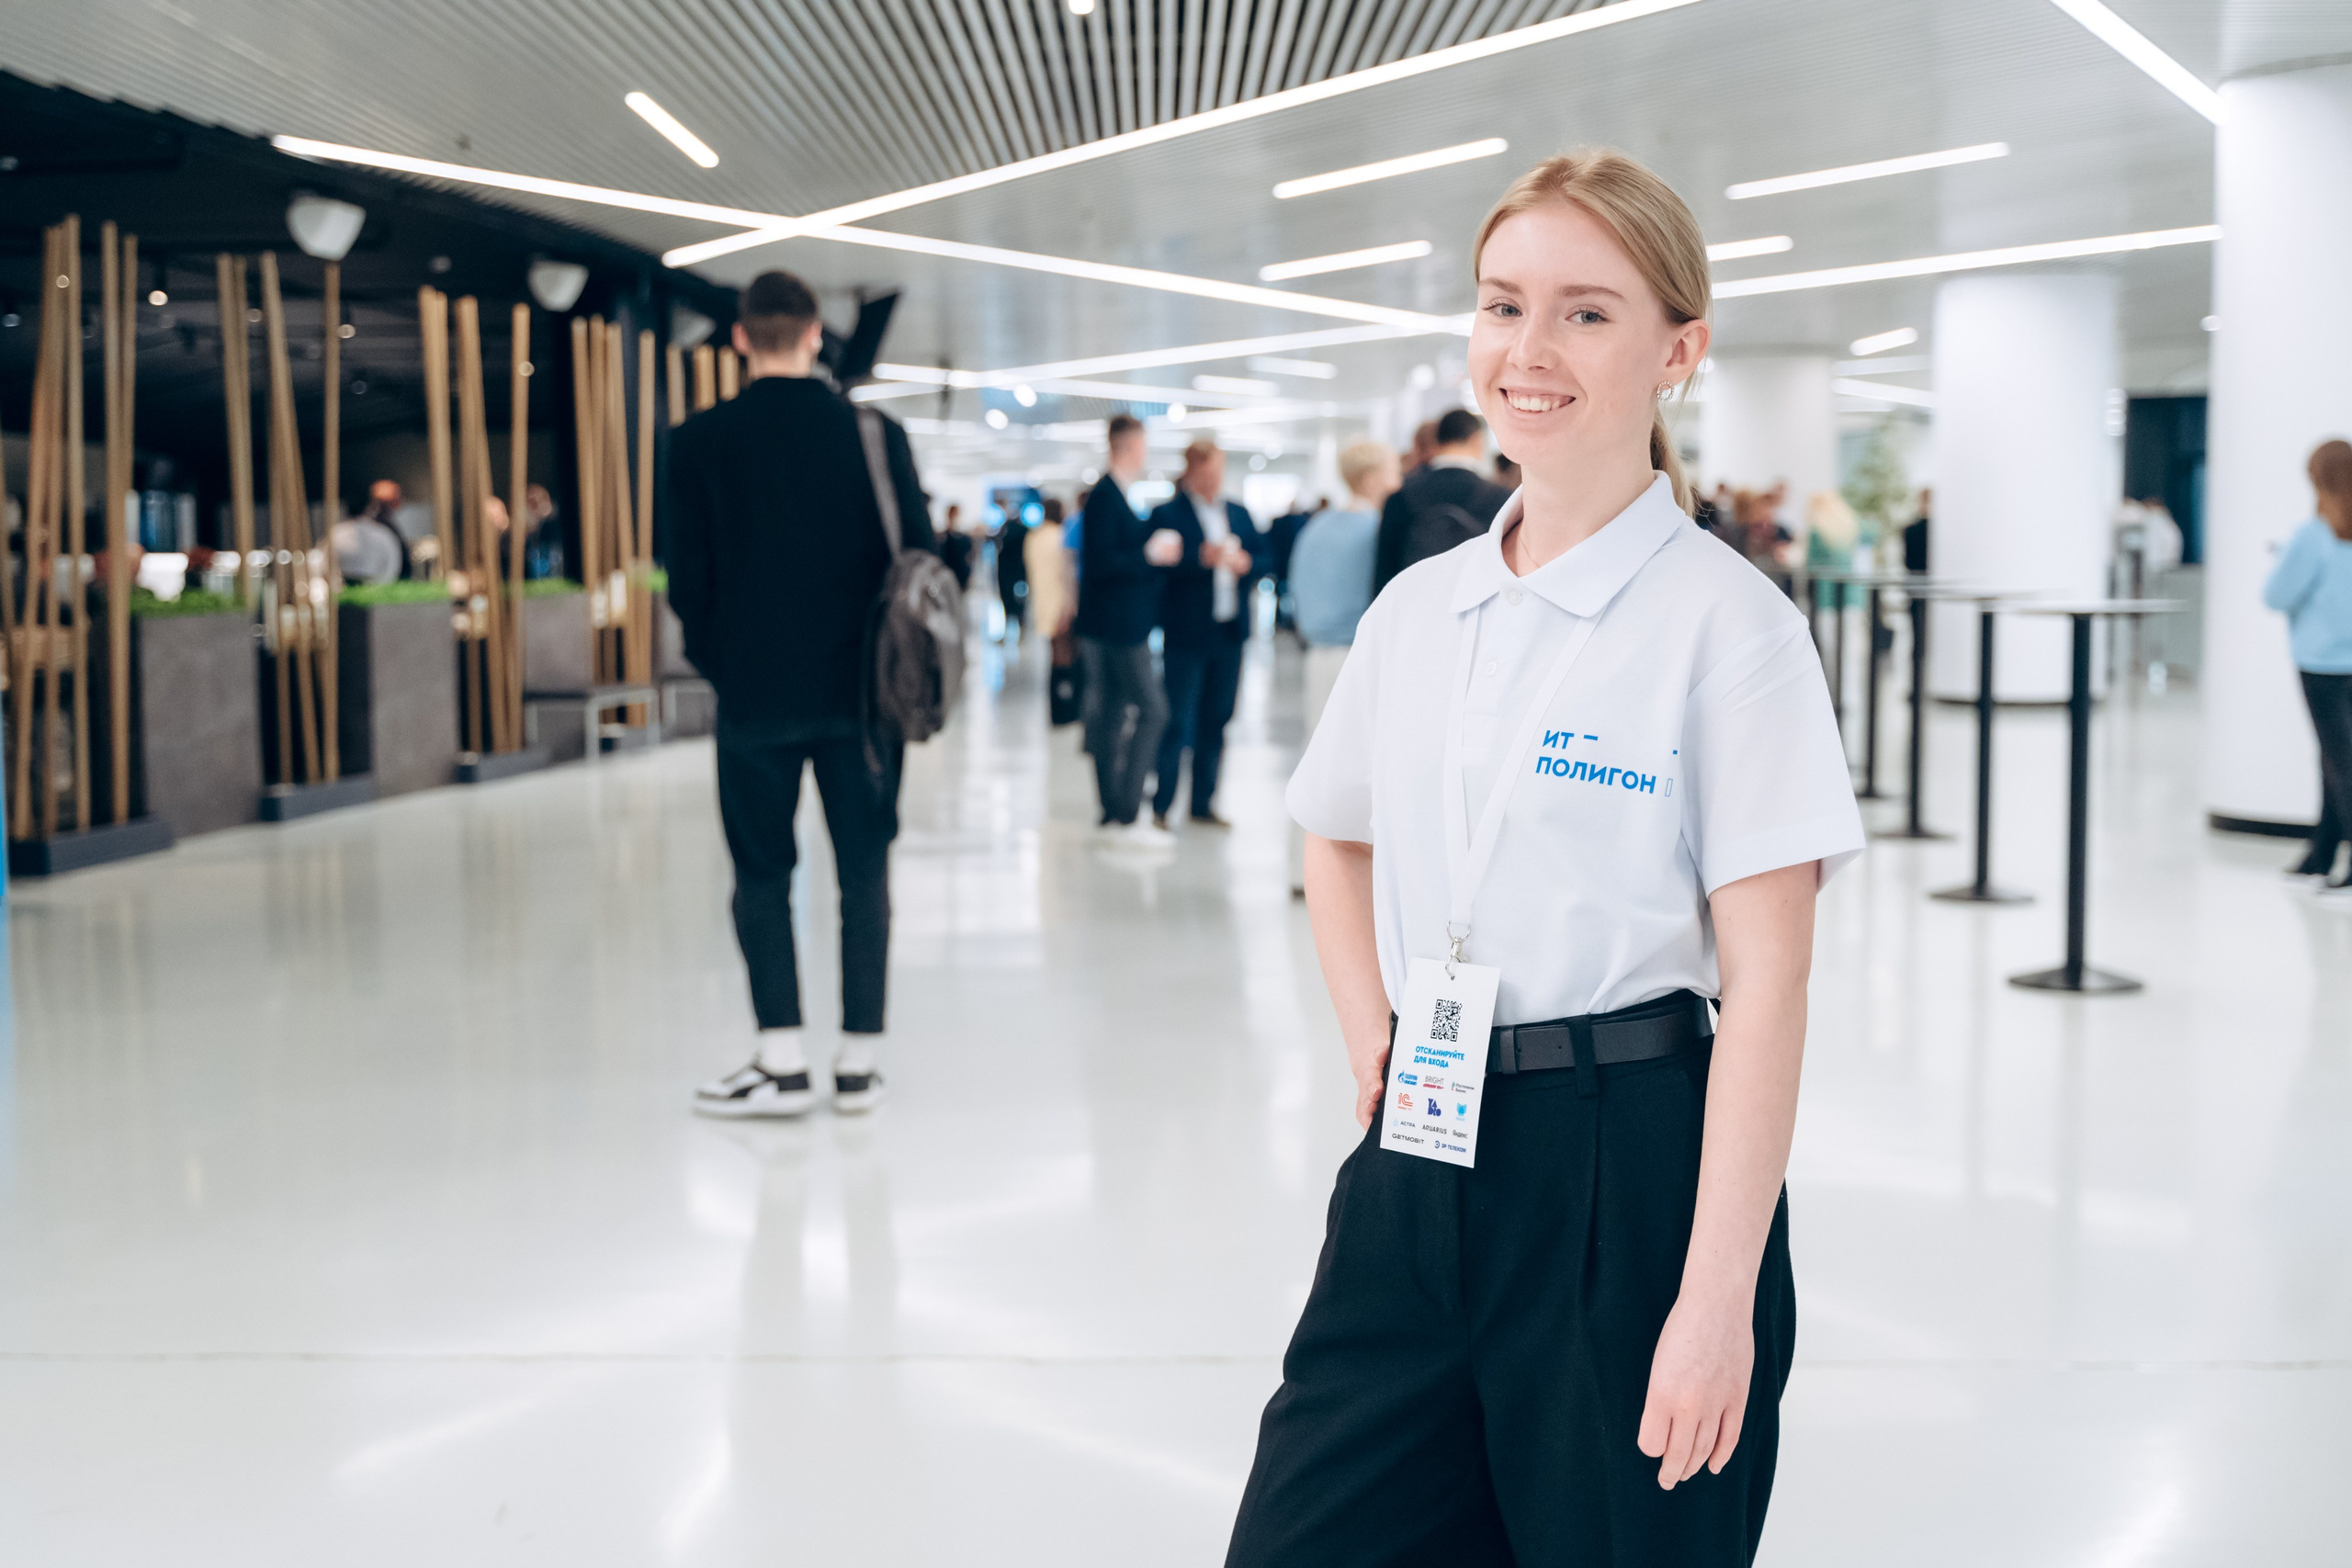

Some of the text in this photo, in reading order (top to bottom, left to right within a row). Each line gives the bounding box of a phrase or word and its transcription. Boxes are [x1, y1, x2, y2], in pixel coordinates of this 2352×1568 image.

[1543, 730, 1575, 750] ИТ
[1535, 756, 1657, 795] ПОЛИГОН
[1416, 1045, 1464, 1060] ОТСКАНИРУЙТЕ
[1413, 1055, 1449, 1068] ДЛЯ ВХОДА
[1425, 1076, 1443, 1084] BRIGHT
[1422, 1124, 1448, 1134] AQUARIUS
[1392, 1134, 1424, 1144] GETMOBIT
